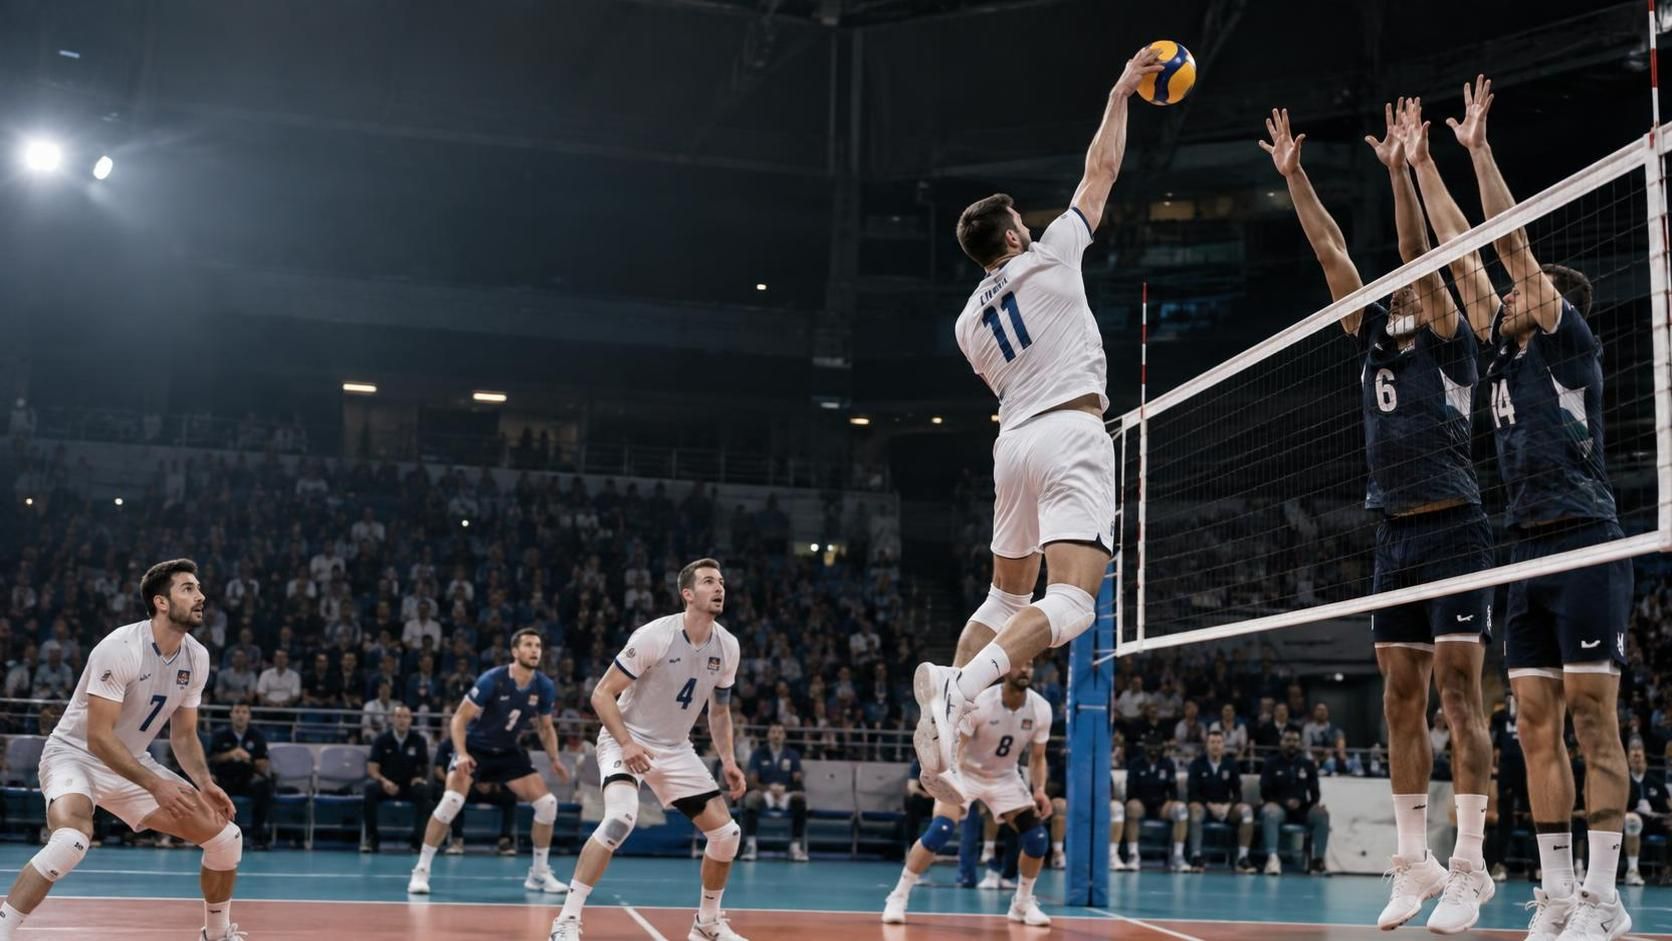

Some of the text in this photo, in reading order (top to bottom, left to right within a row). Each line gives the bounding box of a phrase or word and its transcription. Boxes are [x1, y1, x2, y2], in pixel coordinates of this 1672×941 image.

[982, 291, 1032, 363] 11
[1376, 368, 1397, 412] 6
[1491, 378, 1516, 428] 14
[139, 694, 167, 732] 7
[676, 677, 697, 710] 4
[995, 735, 1014, 757] 8
